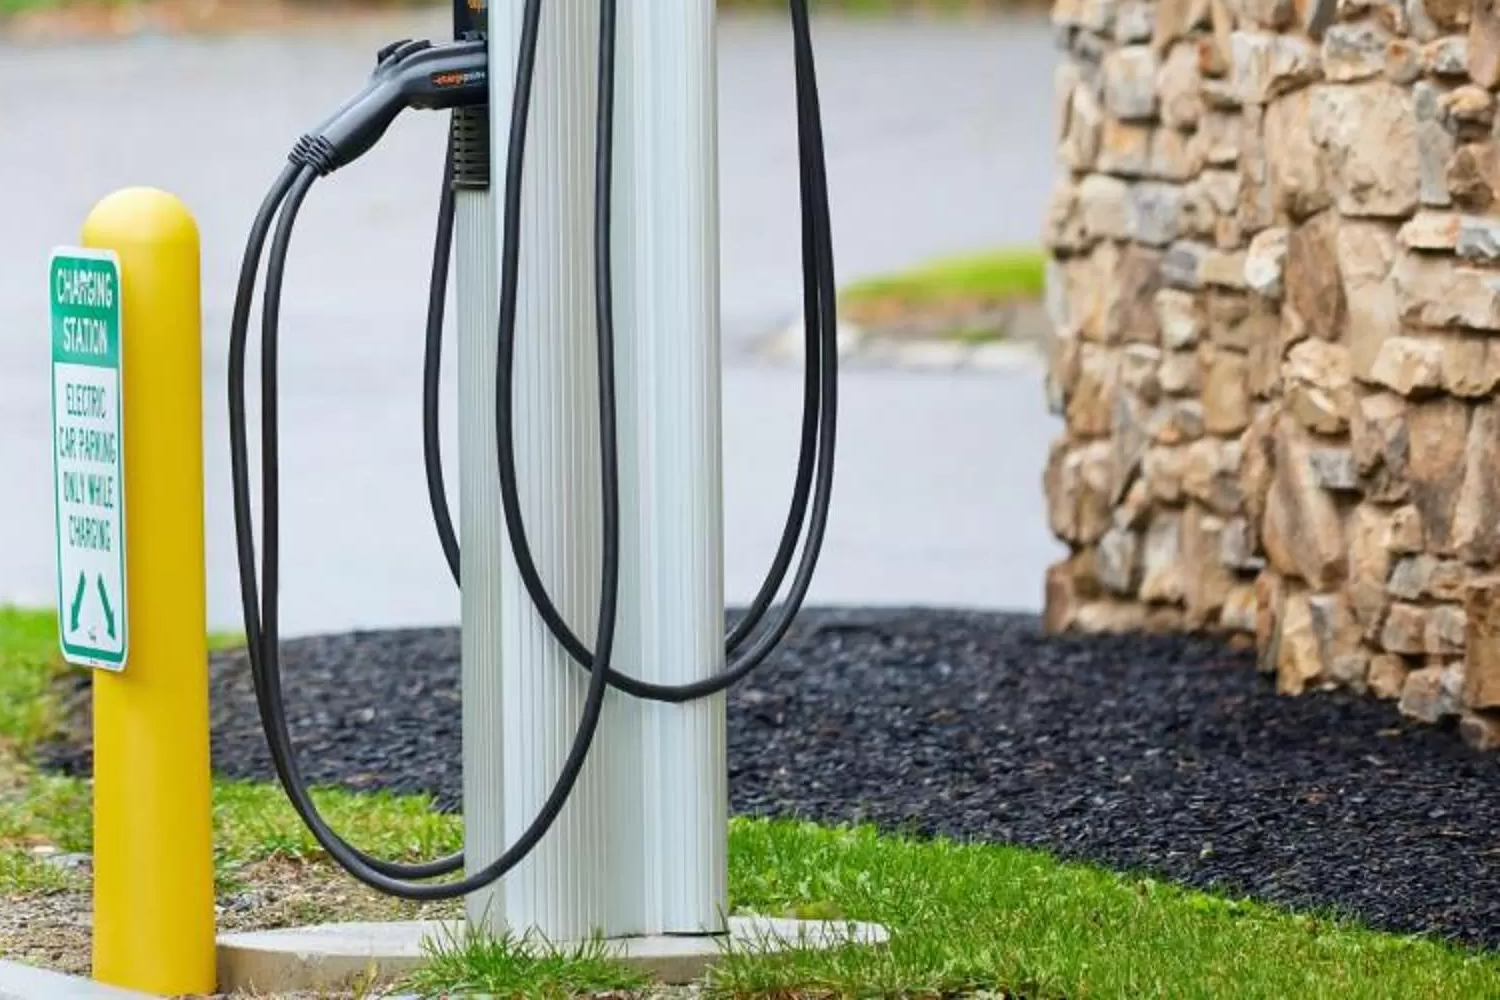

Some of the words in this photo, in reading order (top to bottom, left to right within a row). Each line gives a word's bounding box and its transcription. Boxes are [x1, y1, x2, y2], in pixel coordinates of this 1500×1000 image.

[57, 267, 113, 309] CHARGING
[63, 316, 107, 355] STATION
[66, 383, 106, 419] ELECTRIC
[59, 425, 77, 460] CAR
[78, 427, 116, 465] PARKING
[64, 471, 85, 504] ONLY
[87, 473, 113, 509] WHILE
[69, 514, 111, 552] CHARGING
